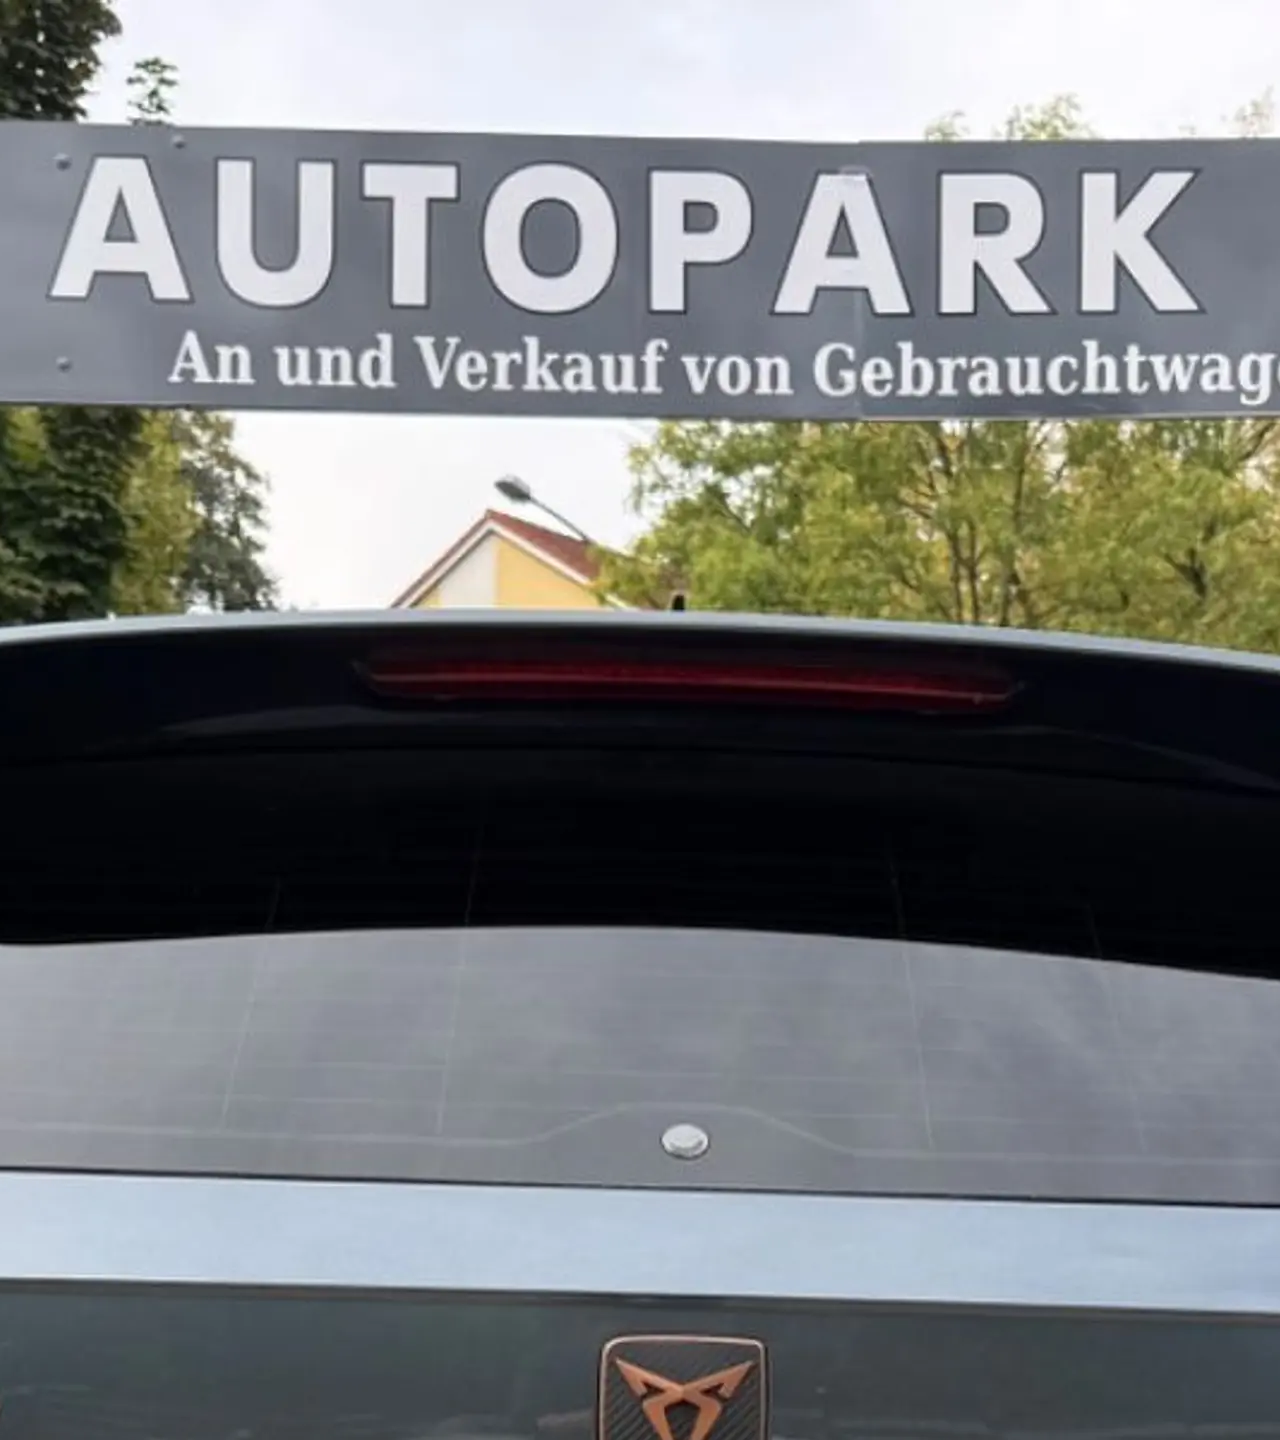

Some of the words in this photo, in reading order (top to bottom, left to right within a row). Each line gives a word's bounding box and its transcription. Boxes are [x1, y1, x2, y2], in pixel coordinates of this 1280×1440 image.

[49, 155, 1200, 315] AUTOPARK
[168, 330, 255, 385] An
[274, 333, 396, 389] und
[414, 335, 669, 393] Verkauf
[680, 355, 794, 396] von
